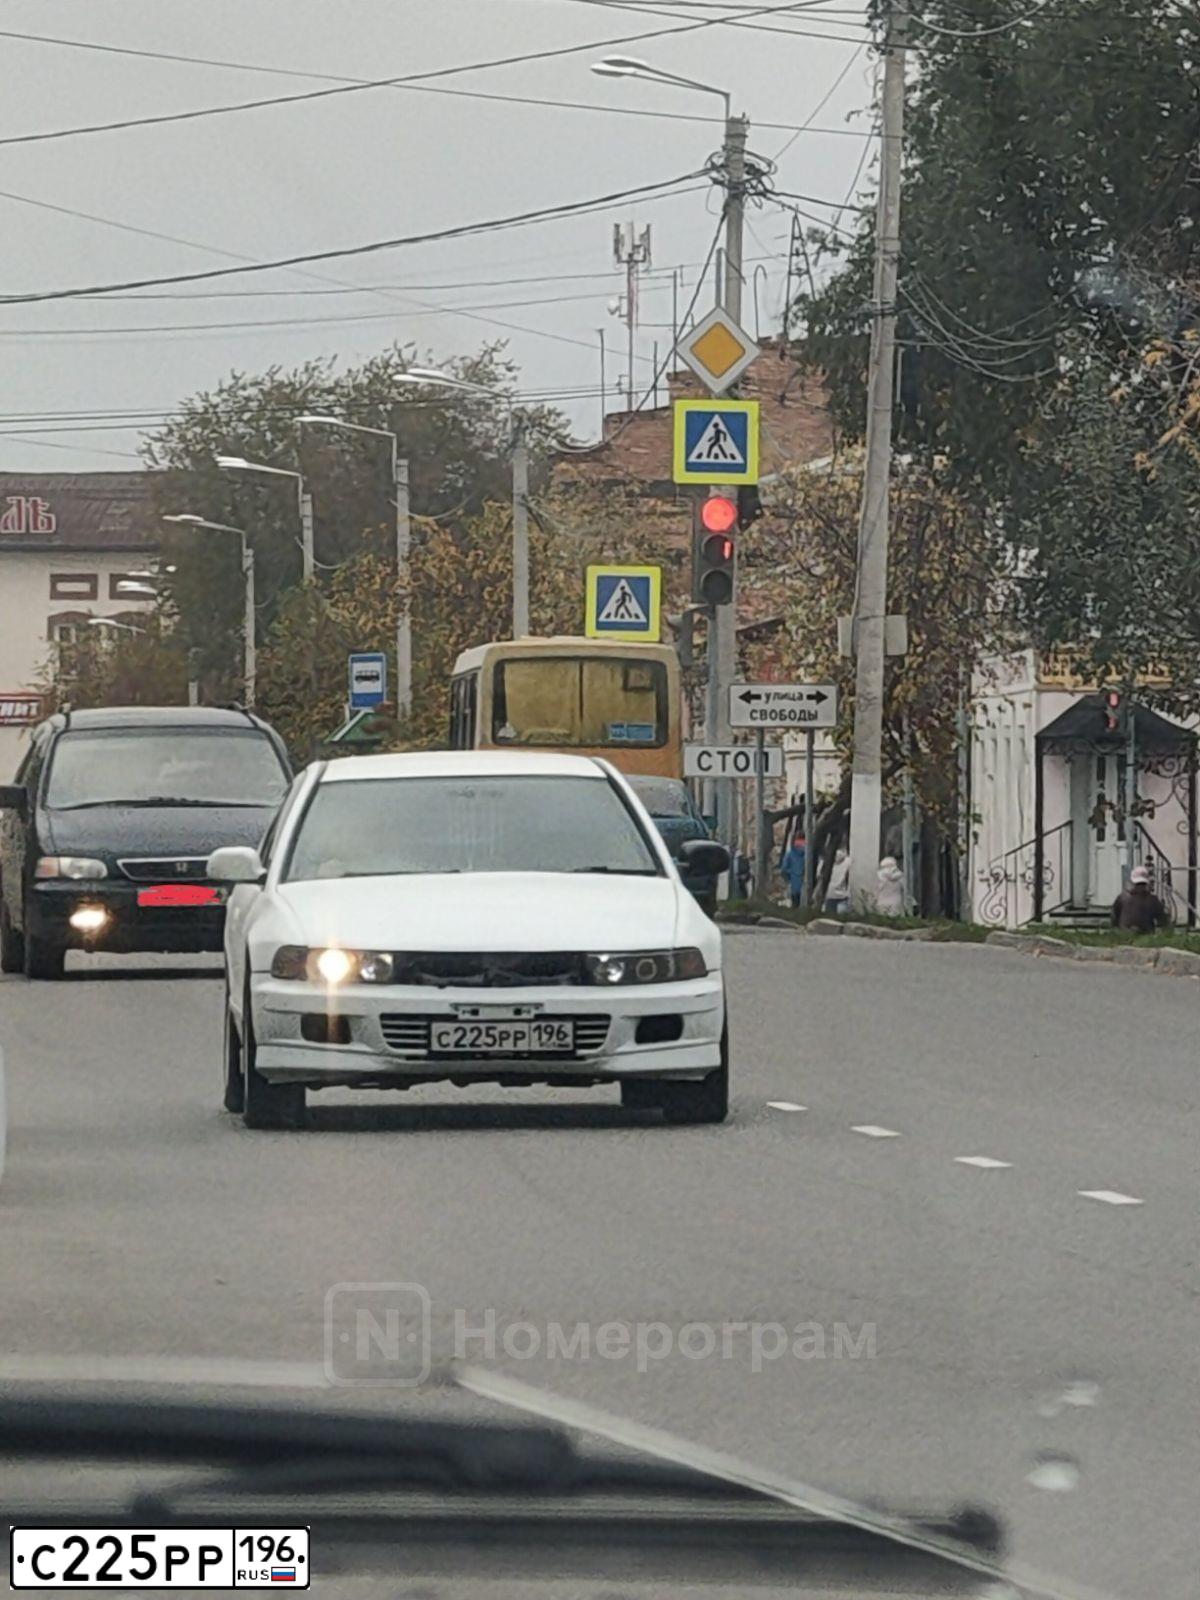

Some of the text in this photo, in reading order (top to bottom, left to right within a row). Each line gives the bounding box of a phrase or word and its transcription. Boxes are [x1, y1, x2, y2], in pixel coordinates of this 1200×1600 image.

[765, 692, 803, 704] улица
[750, 709, 818, 722] СВОБОДЫ
[532, 1024, 568, 1041] 196
